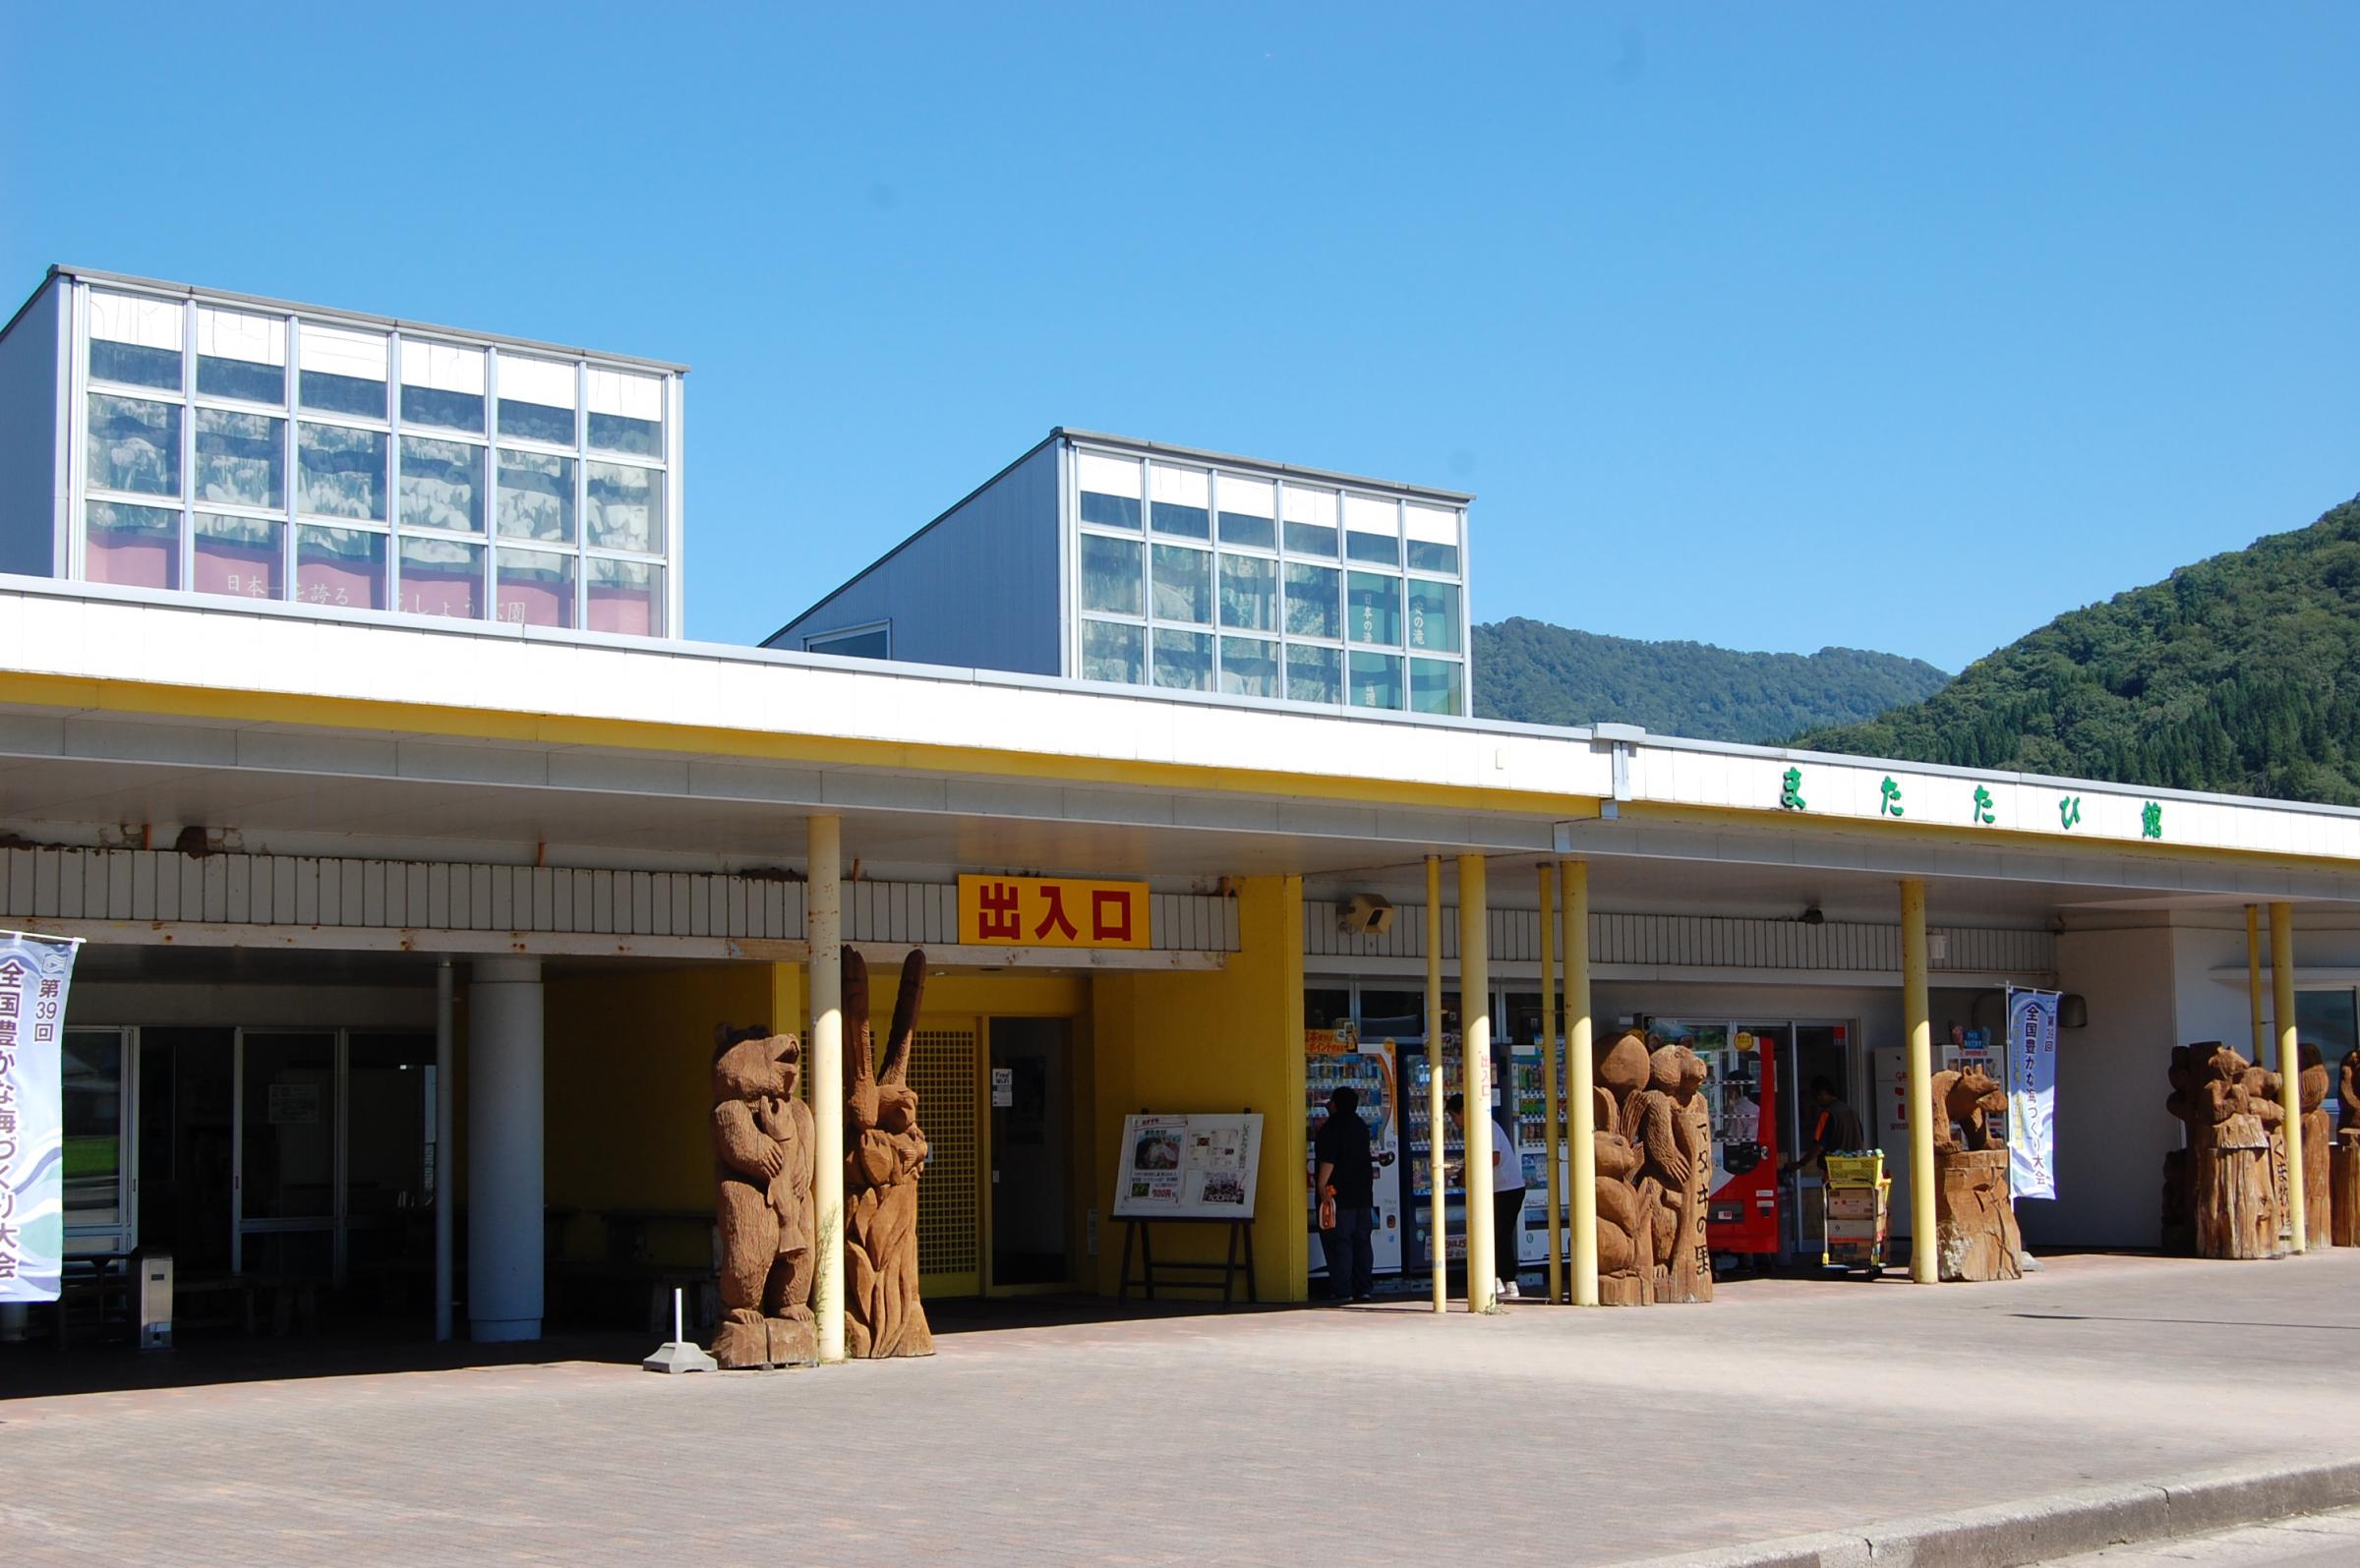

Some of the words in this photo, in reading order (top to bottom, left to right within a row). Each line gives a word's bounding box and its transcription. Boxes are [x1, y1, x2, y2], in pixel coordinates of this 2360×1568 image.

[1780, 766, 2163, 840] またたび館
[977, 882, 1132, 941] 出入口
[33, 978, 60, 1042] 第39回
